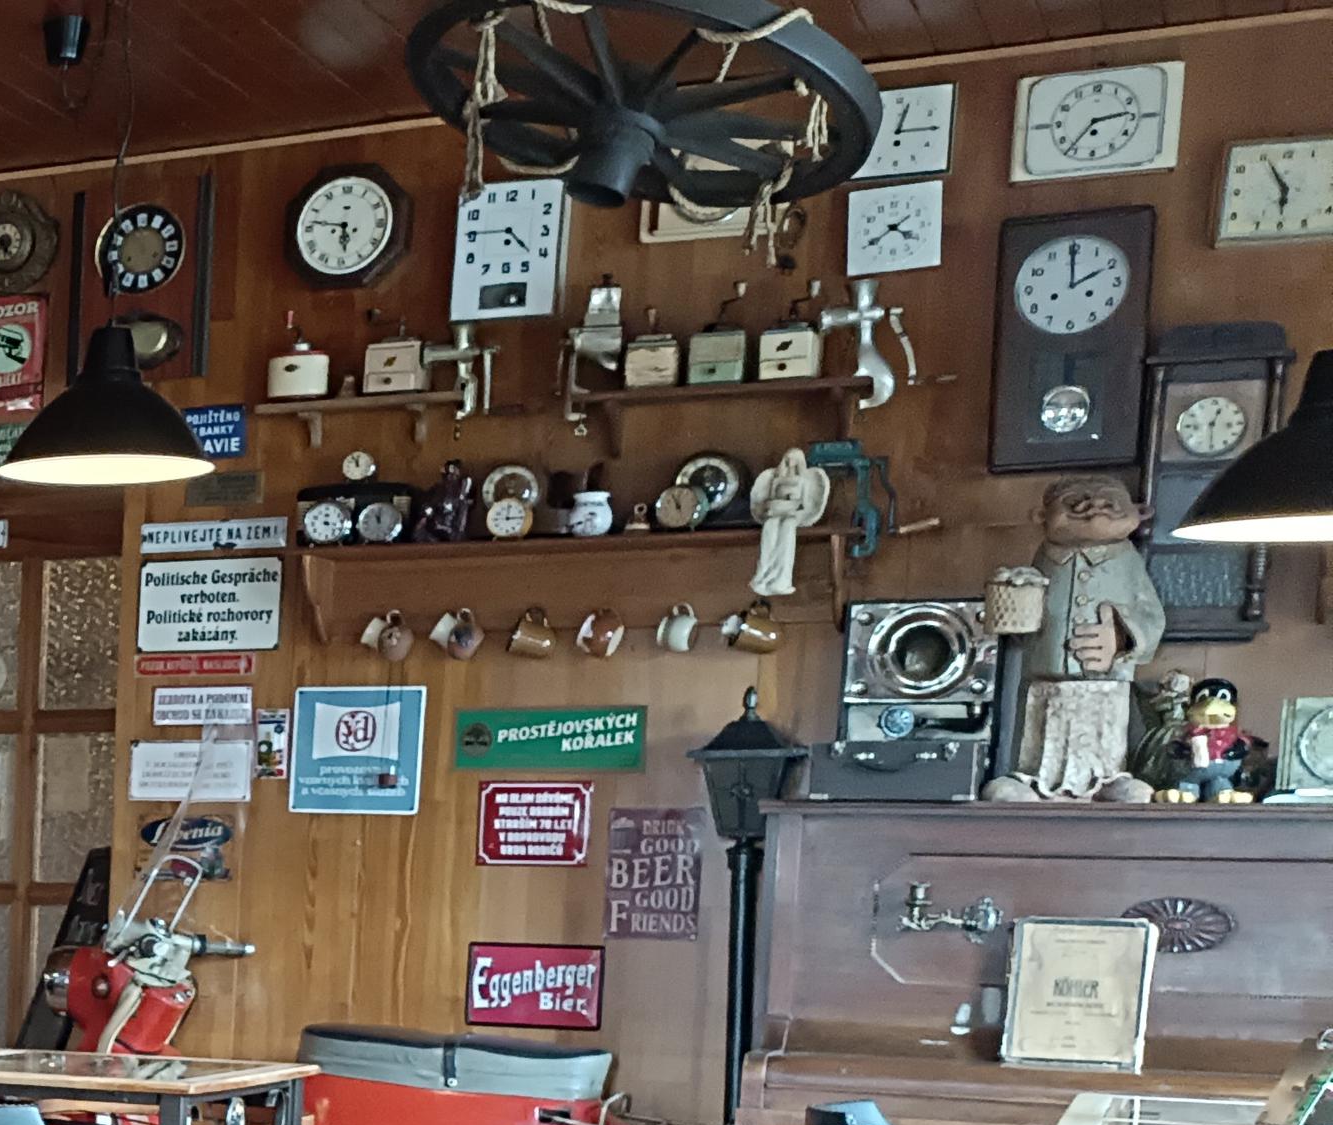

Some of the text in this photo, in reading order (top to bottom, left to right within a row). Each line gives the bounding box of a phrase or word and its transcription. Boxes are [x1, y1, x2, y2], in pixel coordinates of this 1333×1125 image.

[147, 528, 222, 545] NEPLIVEJTE
[228, 528, 242, 541] NA
[145, 567, 279, 587] Politische Gespräche
[180, 590, 240, 604] verboten.
[146, 607, 273, 625] Politické rozhovory
[497, 711, 638, 743] PROSTĚJOVSKÝCH
[561, 729, 636, 752] KOŘALEK
[642, 819, 685, 836] DRINK
[640, 837, 700, 855] GOOD
[610, 854, 695, 889] BEER
[635, 887, 694, 911] GOOD
[610, 900, 697, 933] FRIENDS
[472, 957, 596, 1008] Eggenberger
